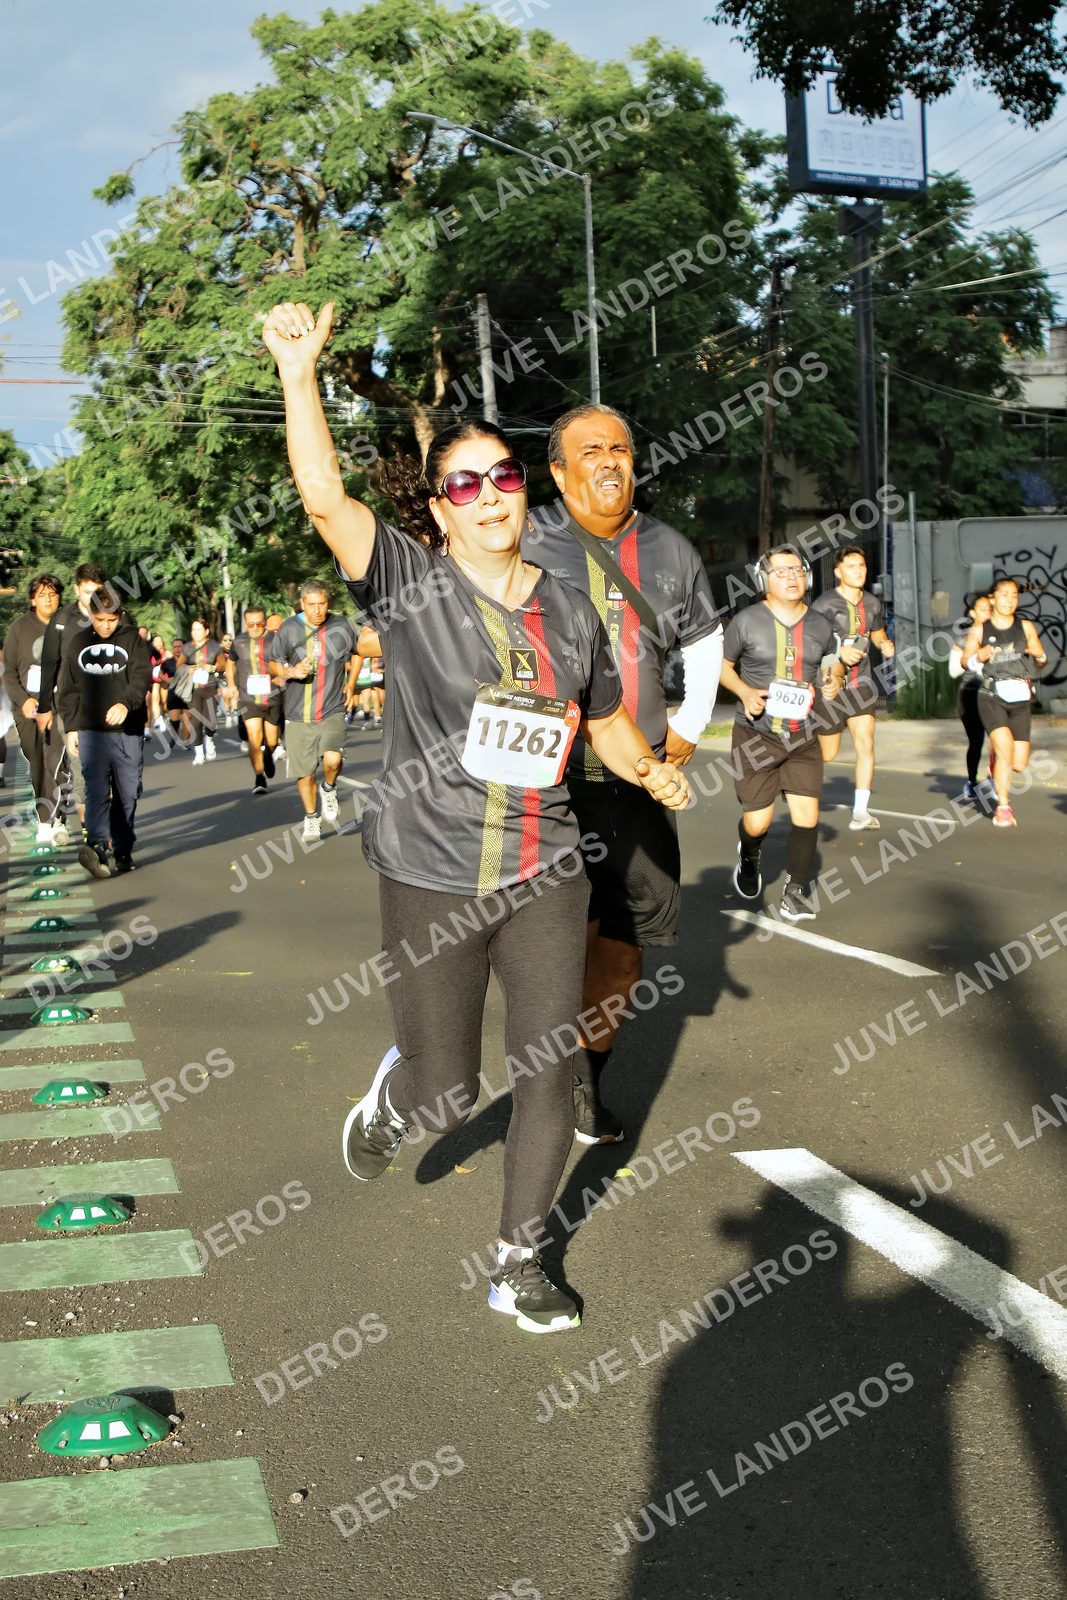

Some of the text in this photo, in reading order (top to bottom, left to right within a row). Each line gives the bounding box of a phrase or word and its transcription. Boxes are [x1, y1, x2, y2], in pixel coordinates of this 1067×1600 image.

[994, 544, 1058, 570] TOY
[775, 689, 806, 706] 9620
[478, 716, 562, 759] 11262
